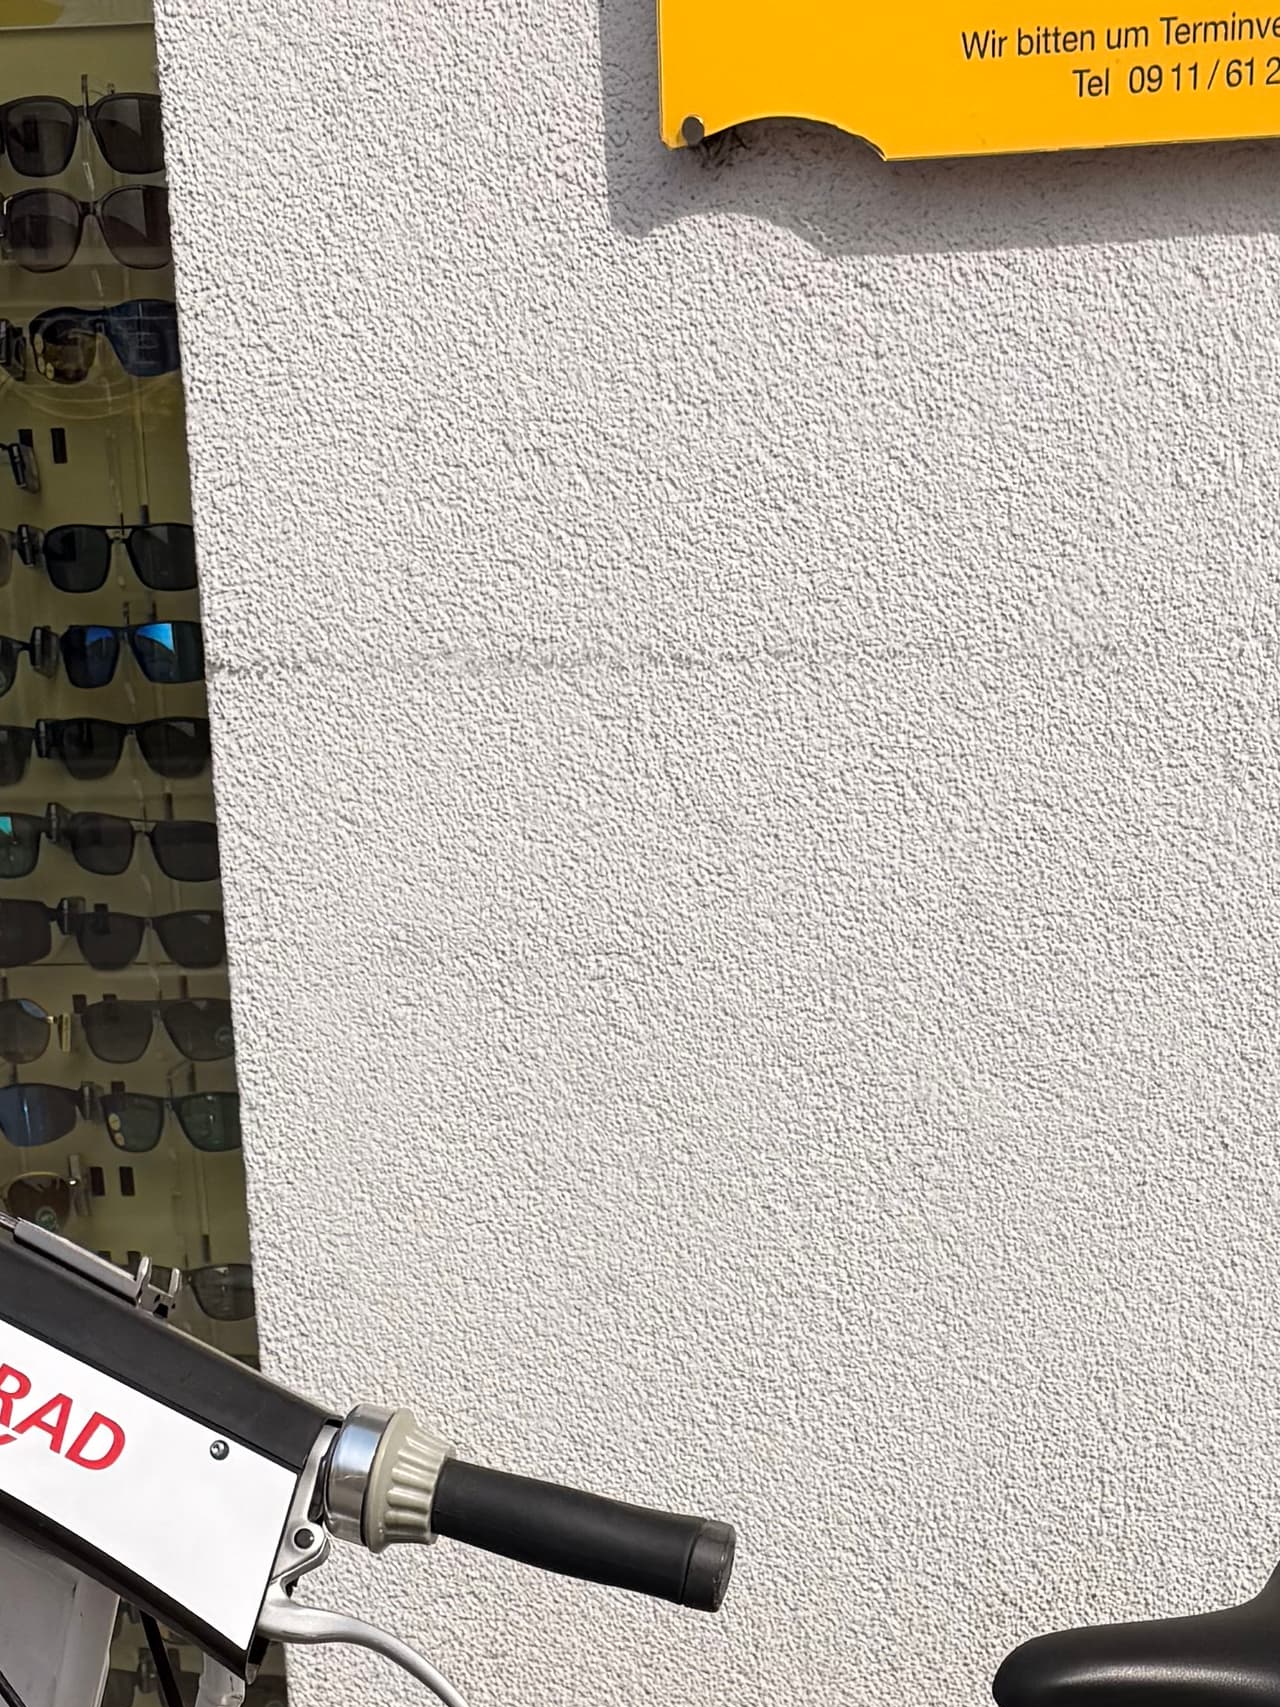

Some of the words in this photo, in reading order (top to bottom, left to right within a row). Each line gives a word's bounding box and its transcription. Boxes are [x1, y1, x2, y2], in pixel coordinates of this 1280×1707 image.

[961, 29, 1008, 60] Wir
[1017, 26, 1095, 56] bitten
[1106, 24, 1149, 49] um
[1073, 67, 1110, 97] Tel
[1128, 64, 1163, 95] 09
[1225, 57, 1254, 87] 61
